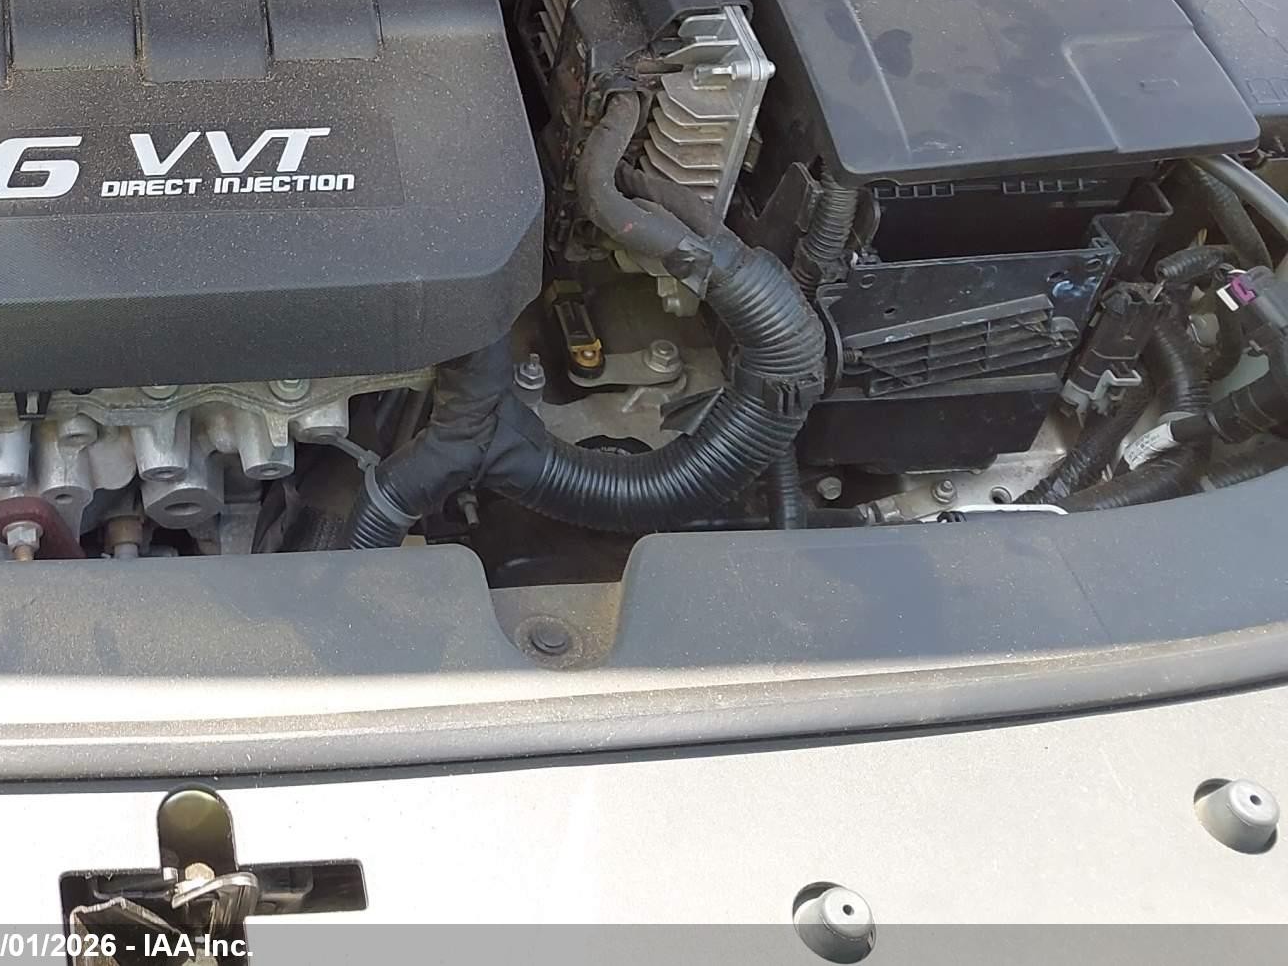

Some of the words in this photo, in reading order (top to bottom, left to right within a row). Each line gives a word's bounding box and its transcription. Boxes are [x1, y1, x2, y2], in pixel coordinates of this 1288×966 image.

[130, 128, 331, 176] VVT
[101, 178, 202, 197] DIRECT
[214, 174, 355, 194] INJECTION
